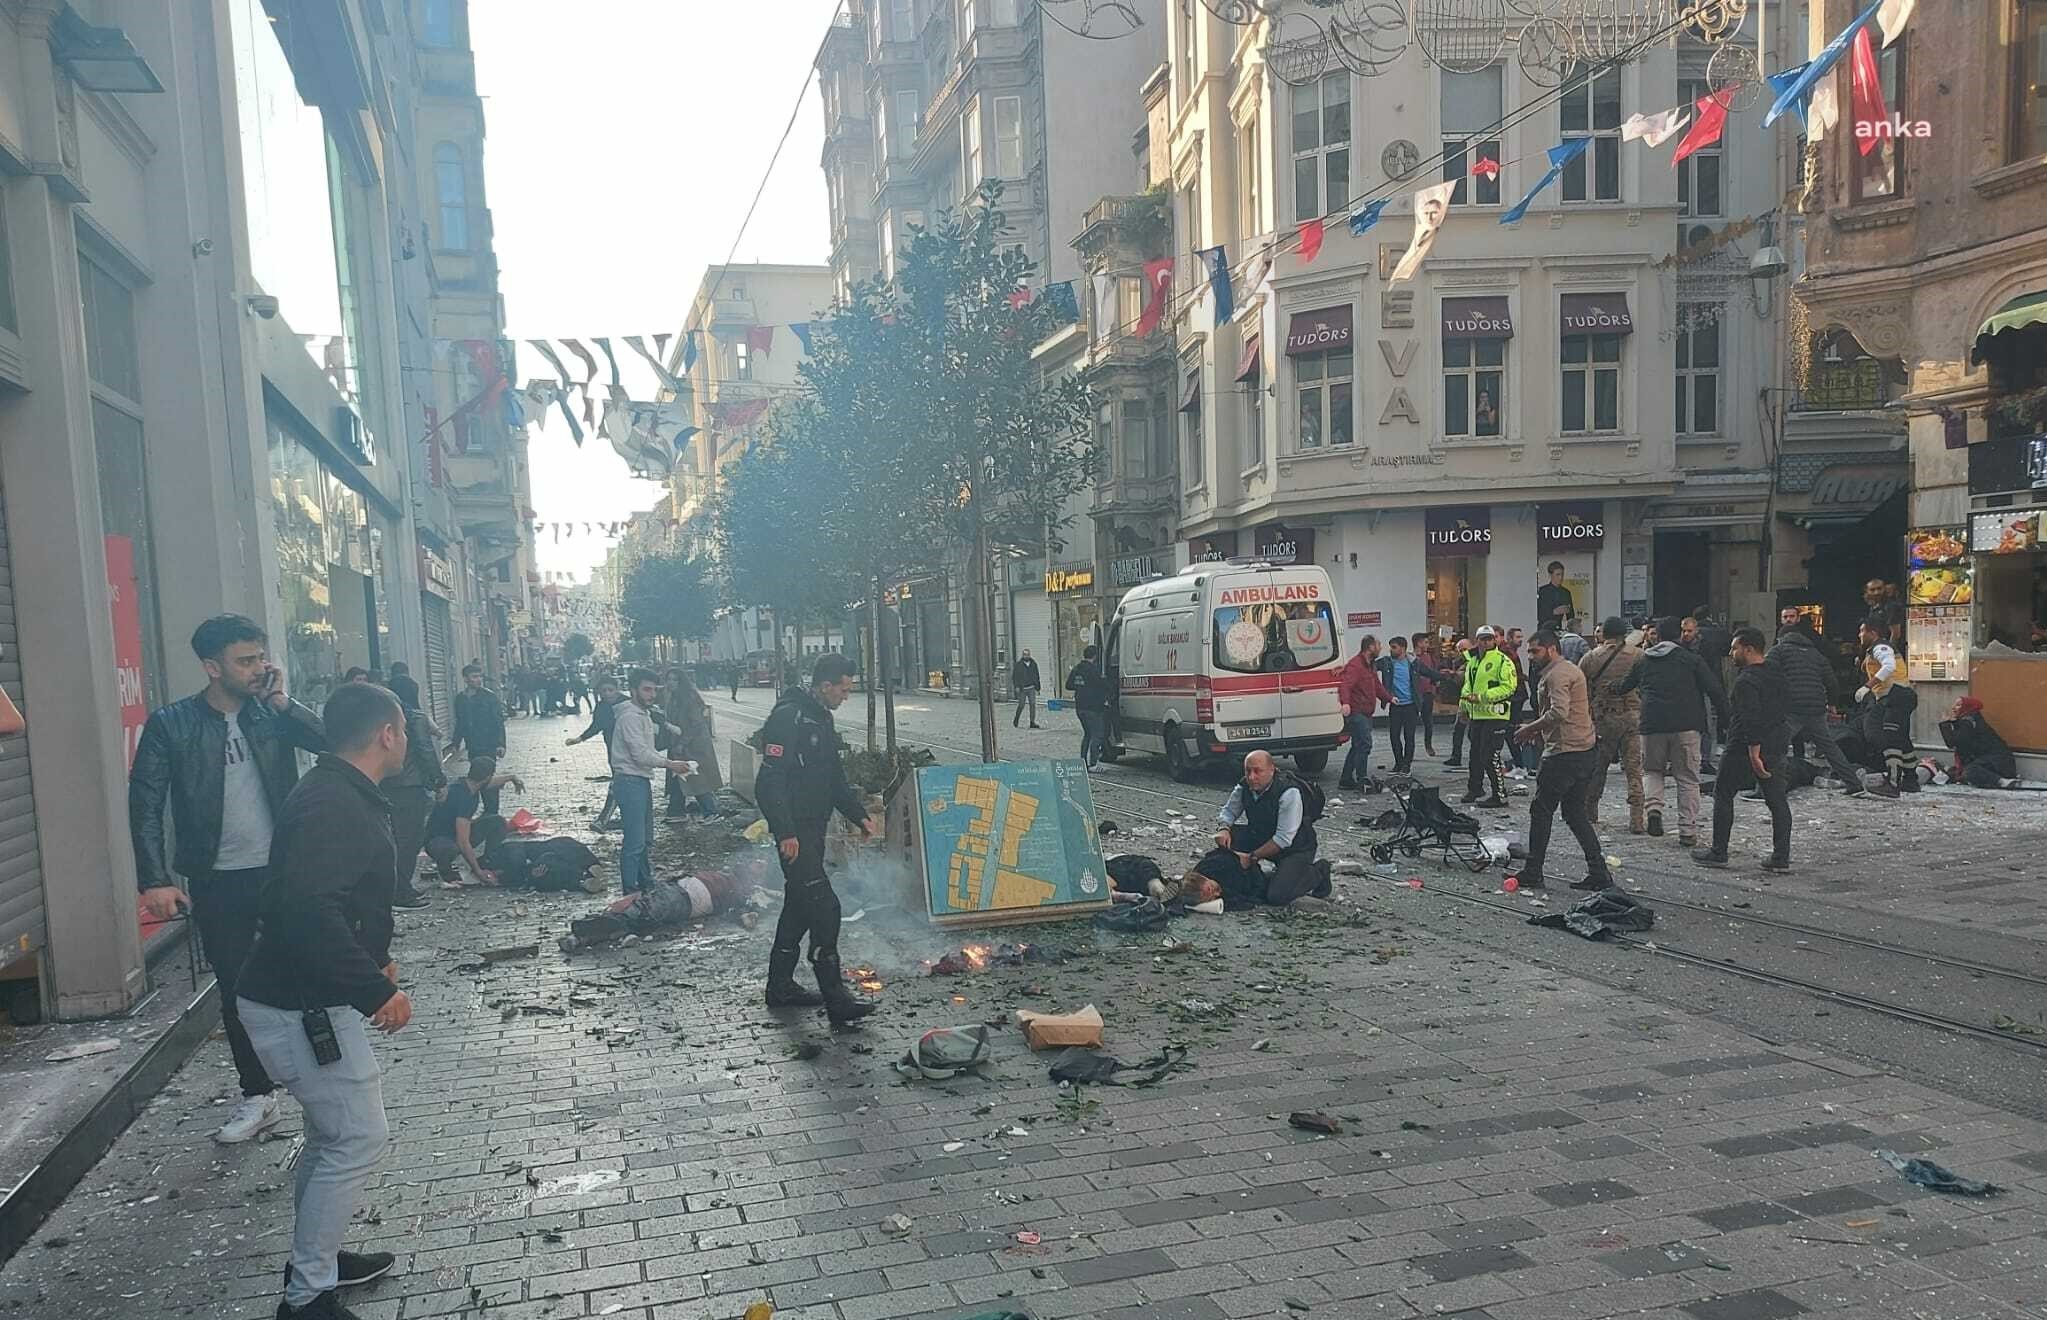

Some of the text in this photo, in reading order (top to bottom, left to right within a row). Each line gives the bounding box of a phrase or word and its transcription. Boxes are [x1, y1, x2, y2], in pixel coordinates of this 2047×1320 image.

[1445, 319, 1511, 332] TUDORS
[1565, 313, 1631, 328] TUDORS
[1288, 327, 1349, 347] TUDORS
[1430, 528, 1491, 545] TUDORS
[1542, 524, 1604, 540] TUDORS
[1262, 541, 1297, 557] TUDORS
[1045, 570, 1065, 593] D&P
[1220, 584, 1319, 605] AMBULANS
